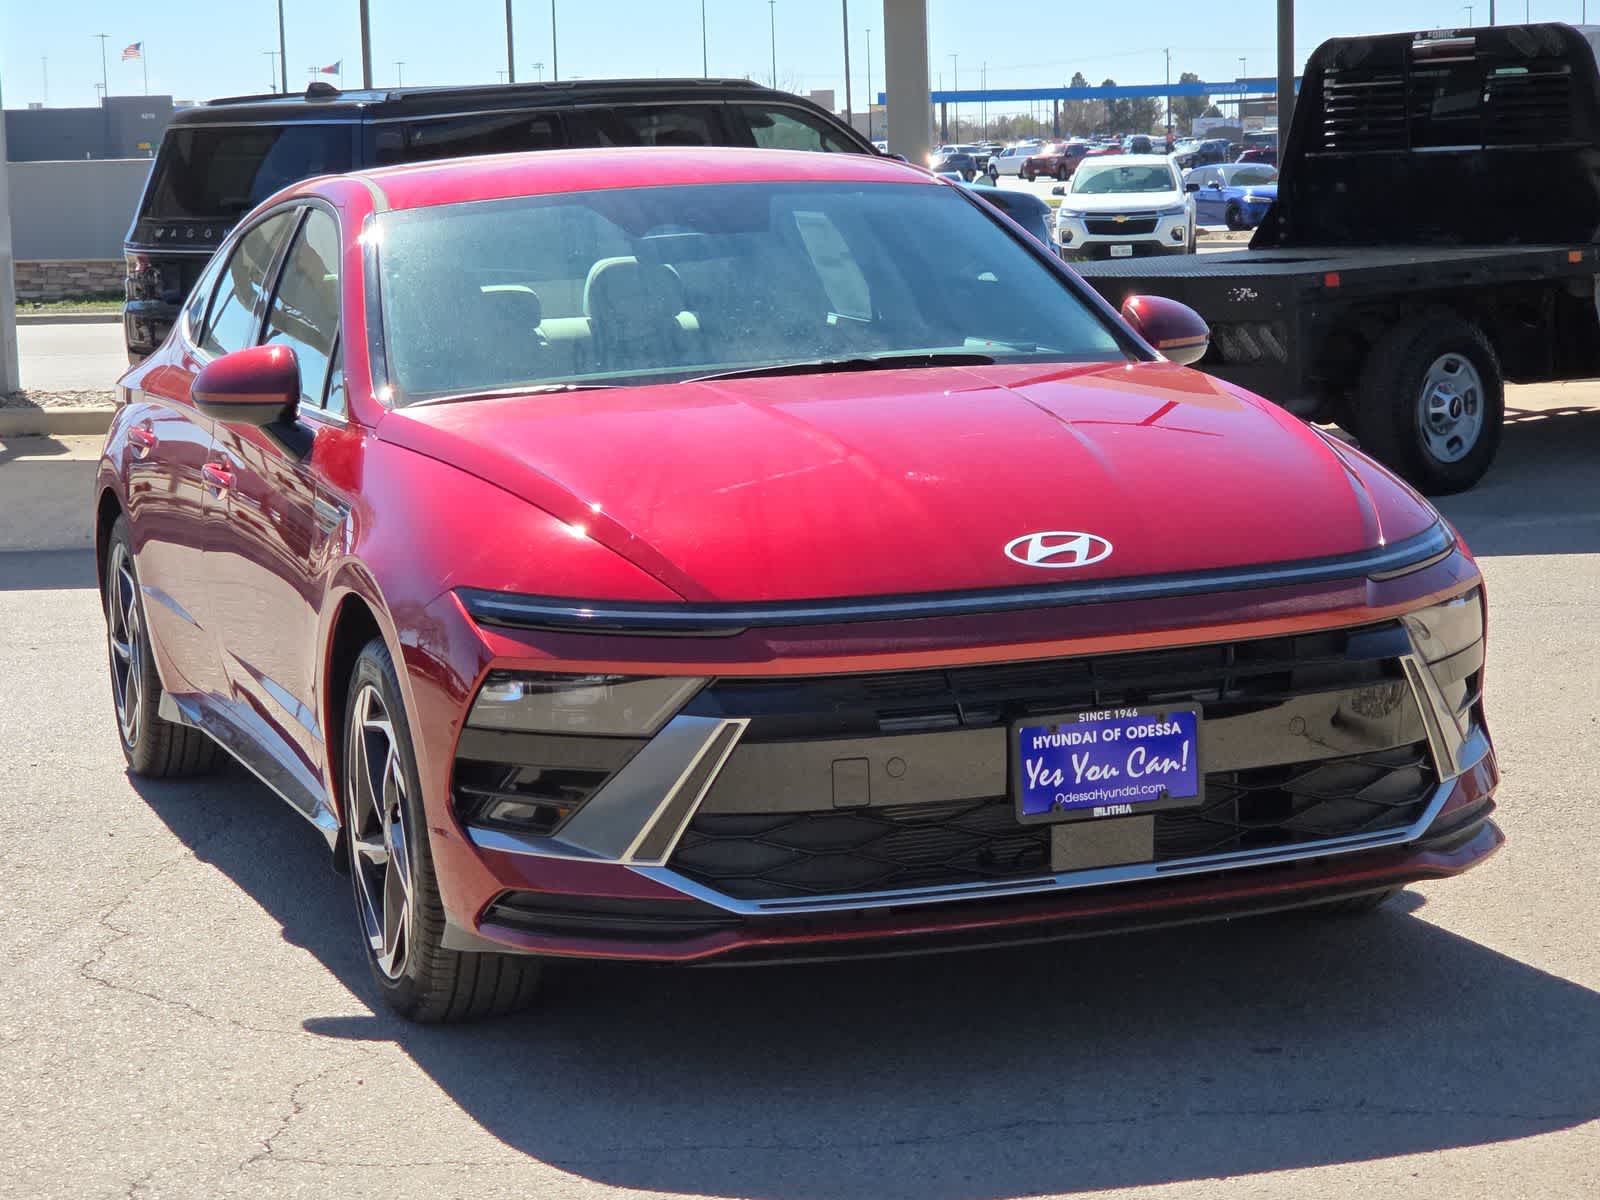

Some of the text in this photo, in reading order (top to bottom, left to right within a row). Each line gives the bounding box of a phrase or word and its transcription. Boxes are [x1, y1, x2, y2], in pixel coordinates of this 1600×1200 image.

[1078, 708, 1138, 722] SINCE 1946
[1033, 722, 1182, 749] HYUNDAI OF ODESSA
[1025, 740, 1189, 789] Yes You Can!
[1055, 783, 1166, 803] OdessaHyundai.com
[1103, 804, 1132, 816] LITHIA
